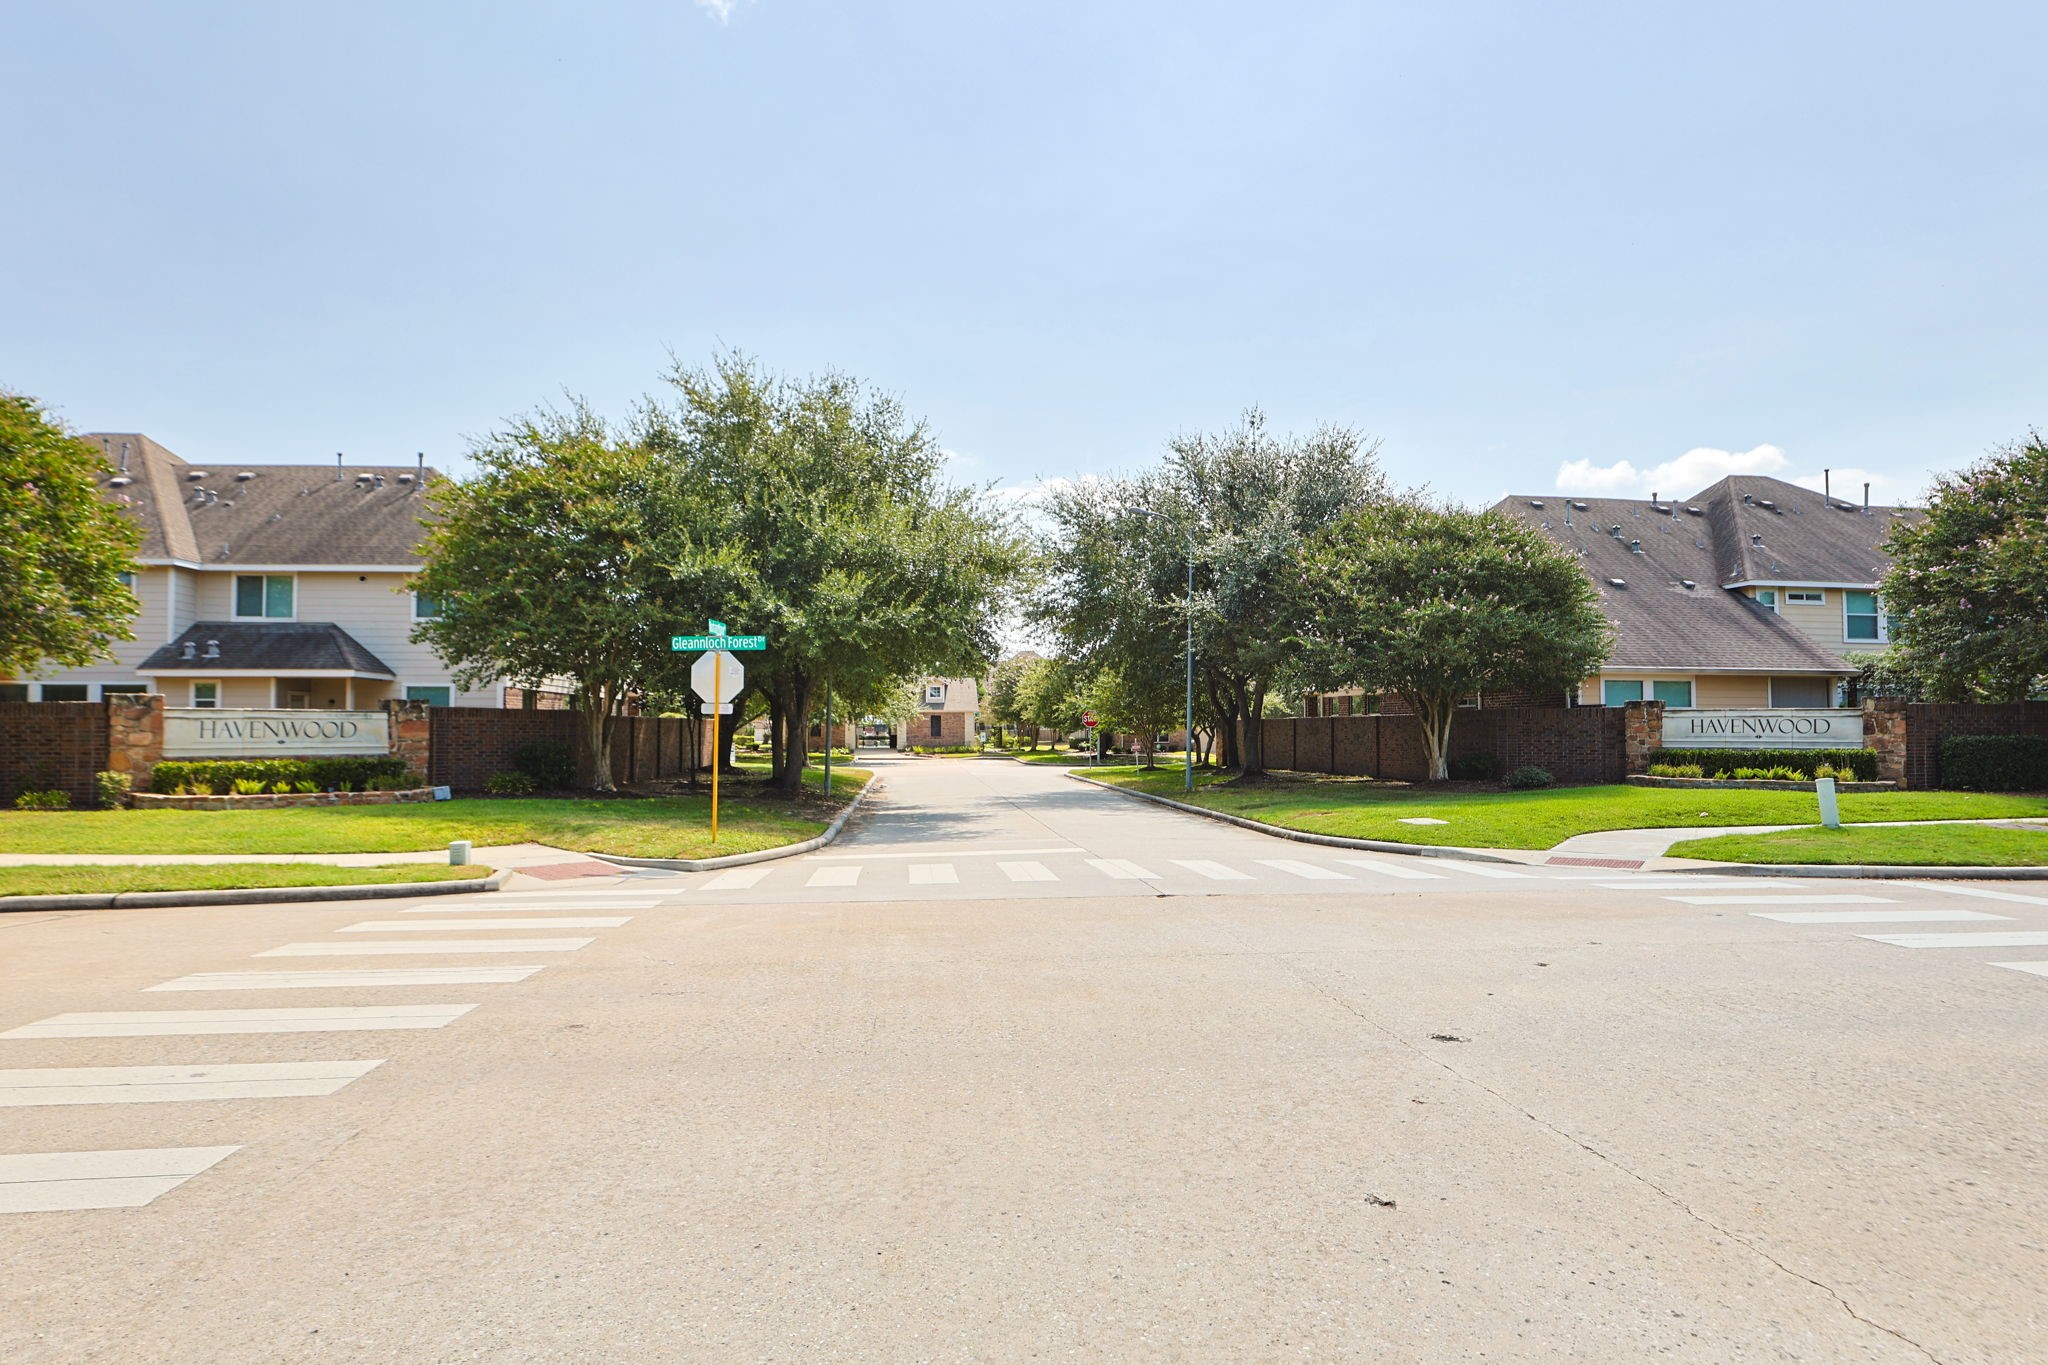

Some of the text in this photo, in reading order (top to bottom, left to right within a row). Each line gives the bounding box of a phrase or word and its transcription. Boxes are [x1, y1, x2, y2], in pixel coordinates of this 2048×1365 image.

[672, 636, 726, 649] Gleannloch
[728, 636, 757, 648] Forest
[200, 720, 357, 739] HAVENWOOD
[1691, 719, 1830, 734] HAVENWOOD
